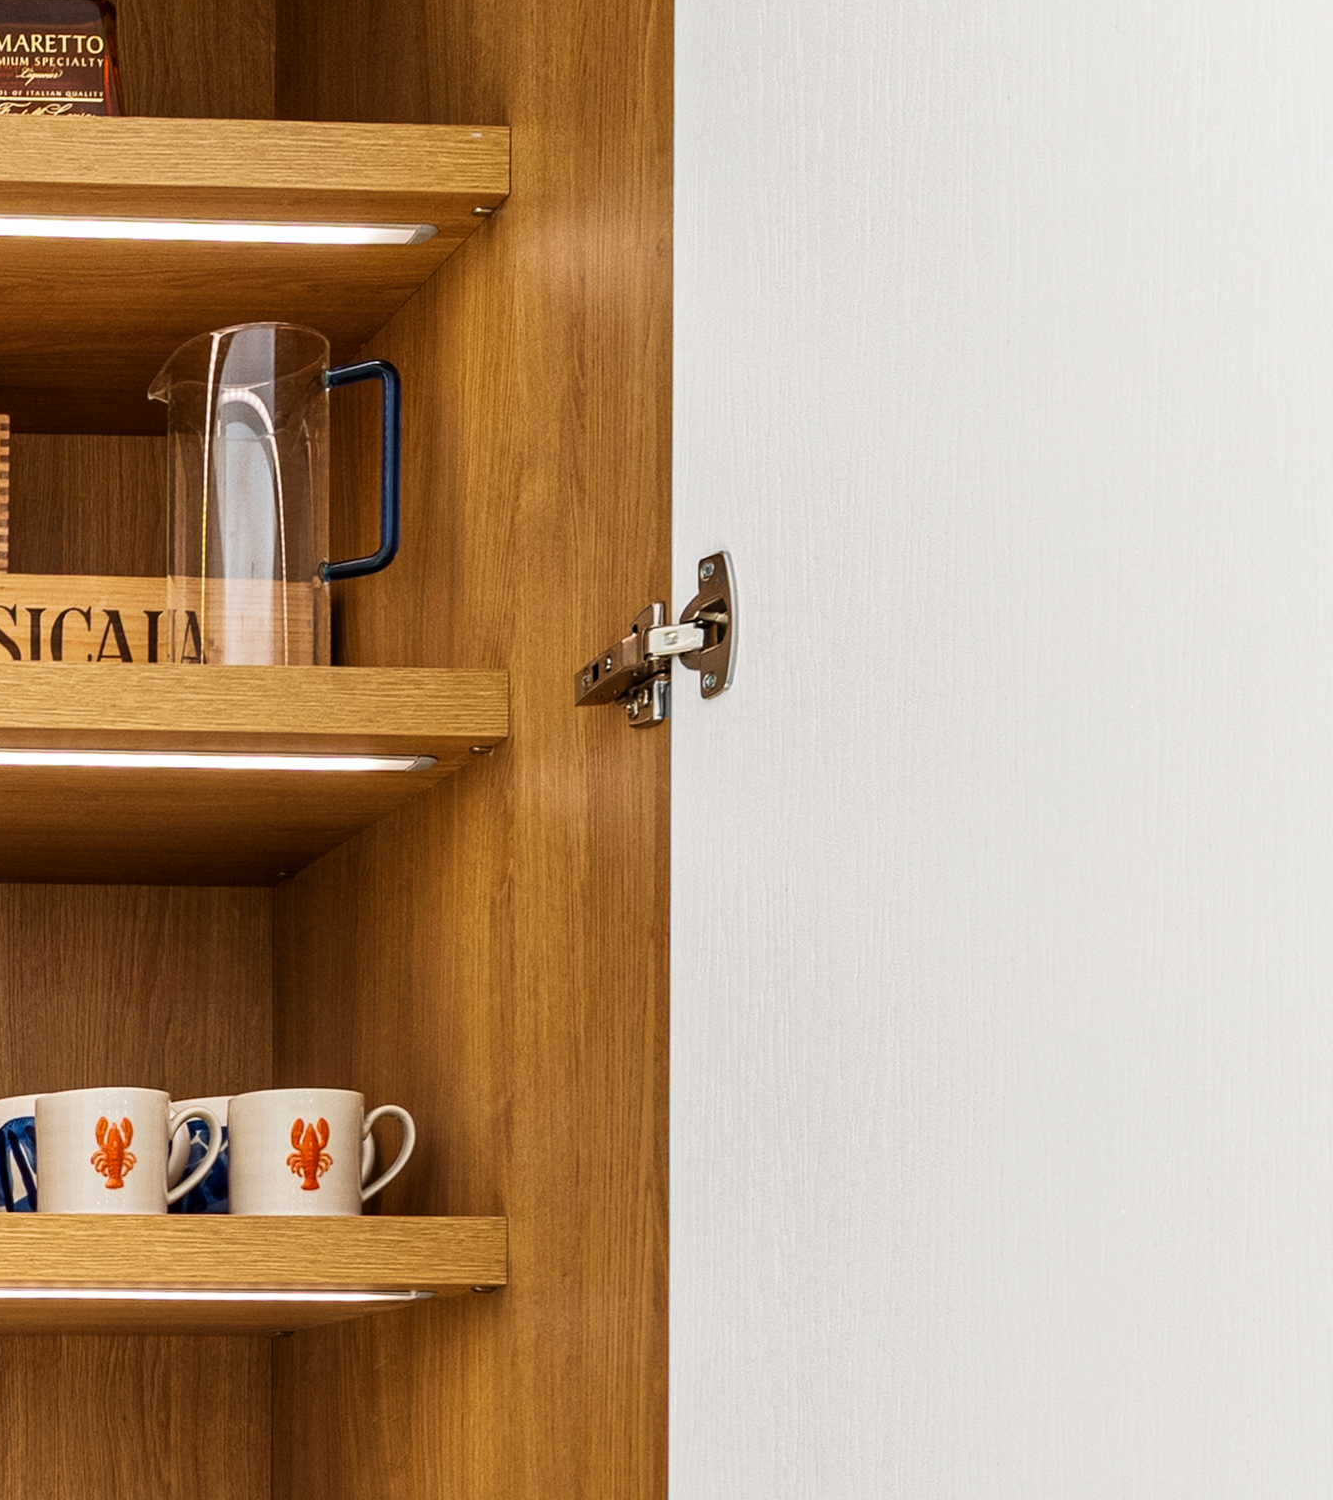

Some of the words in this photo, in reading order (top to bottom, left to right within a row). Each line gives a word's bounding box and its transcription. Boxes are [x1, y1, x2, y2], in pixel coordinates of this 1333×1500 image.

[34, 56, 104, 68] SPECIALTY
[12, 89, 23, 97] OF
[65, 90, 104, 98] QUALITY
